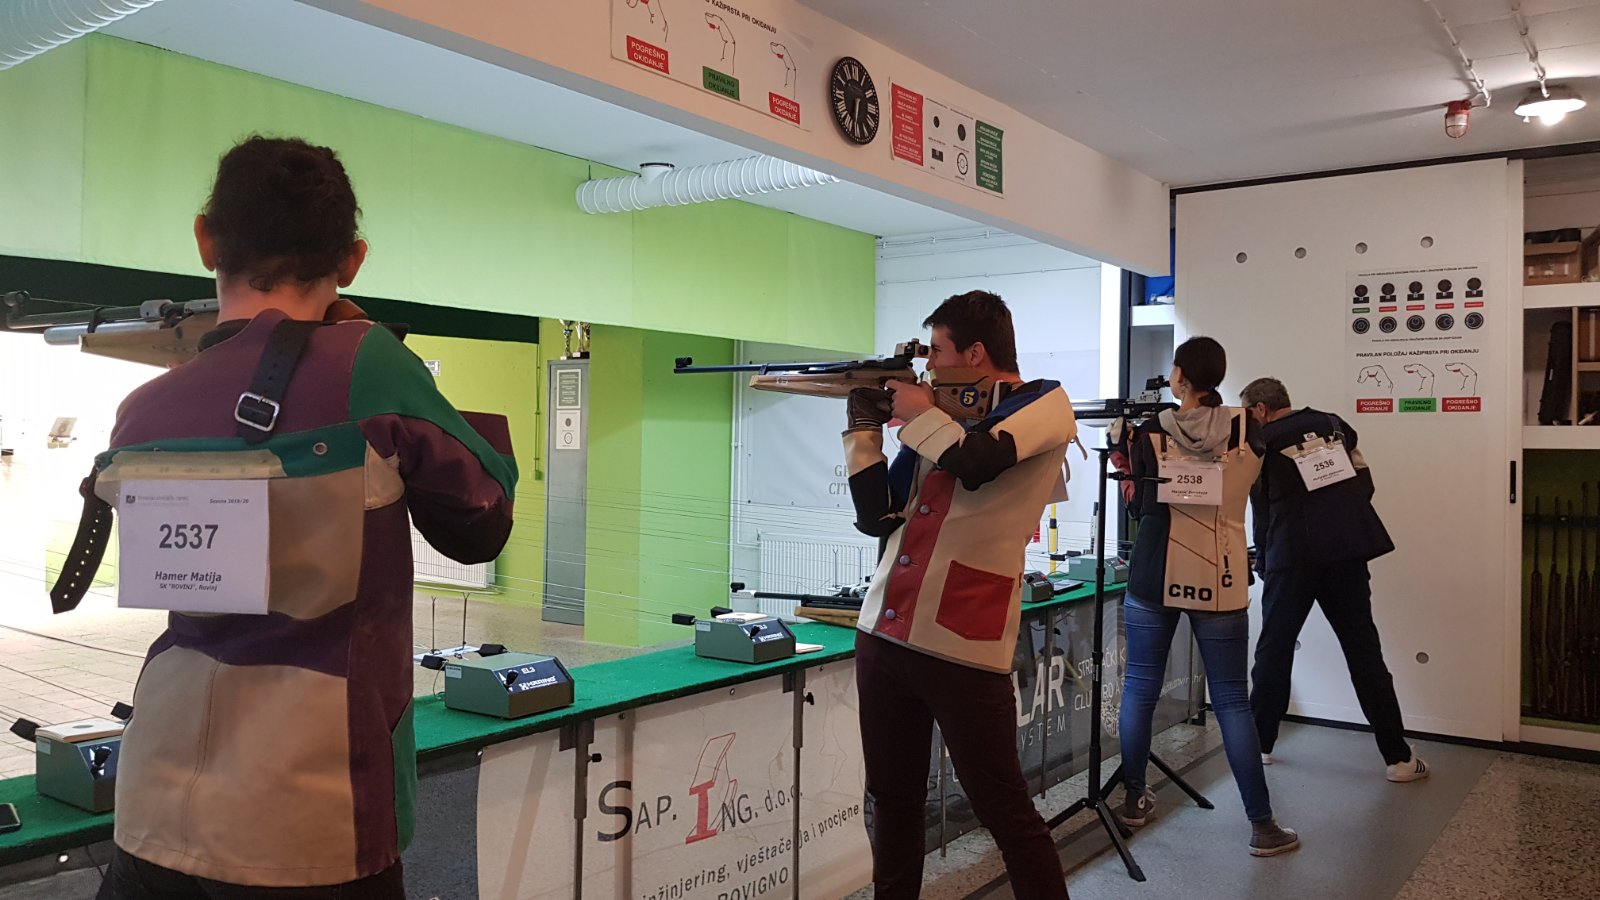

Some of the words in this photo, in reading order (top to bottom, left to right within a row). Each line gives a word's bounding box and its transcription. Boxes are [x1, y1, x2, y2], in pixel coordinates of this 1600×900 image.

[741, 12, 751, 22] PRI
[751, 17, 777, 34] OKIDANJU
[631, 41, 666, 61] POGREŠNO
[633, 52, 665, 70] OKIDANJE
[964, 391, 975, 405] 5
[1313, 459, 1335, 471] 2536
[1177, 474, 1203, 484] 2538
[159, 523, 219, 549] 2537
[154, 571, 188, 582] Hamer
[190, 571, 222, 584] Matija
[1168, 583, 1213, 601] CRO
[1012, 655, 1065, 728] LAR
[1020, 713, 1066, 751] YSTEM
[642, 864, 730, 900] žinjering,
[736, 829, 810, 873] vještačeja
[811, 824, 817, 838] i
[818, 804, 859, 837] procjene
